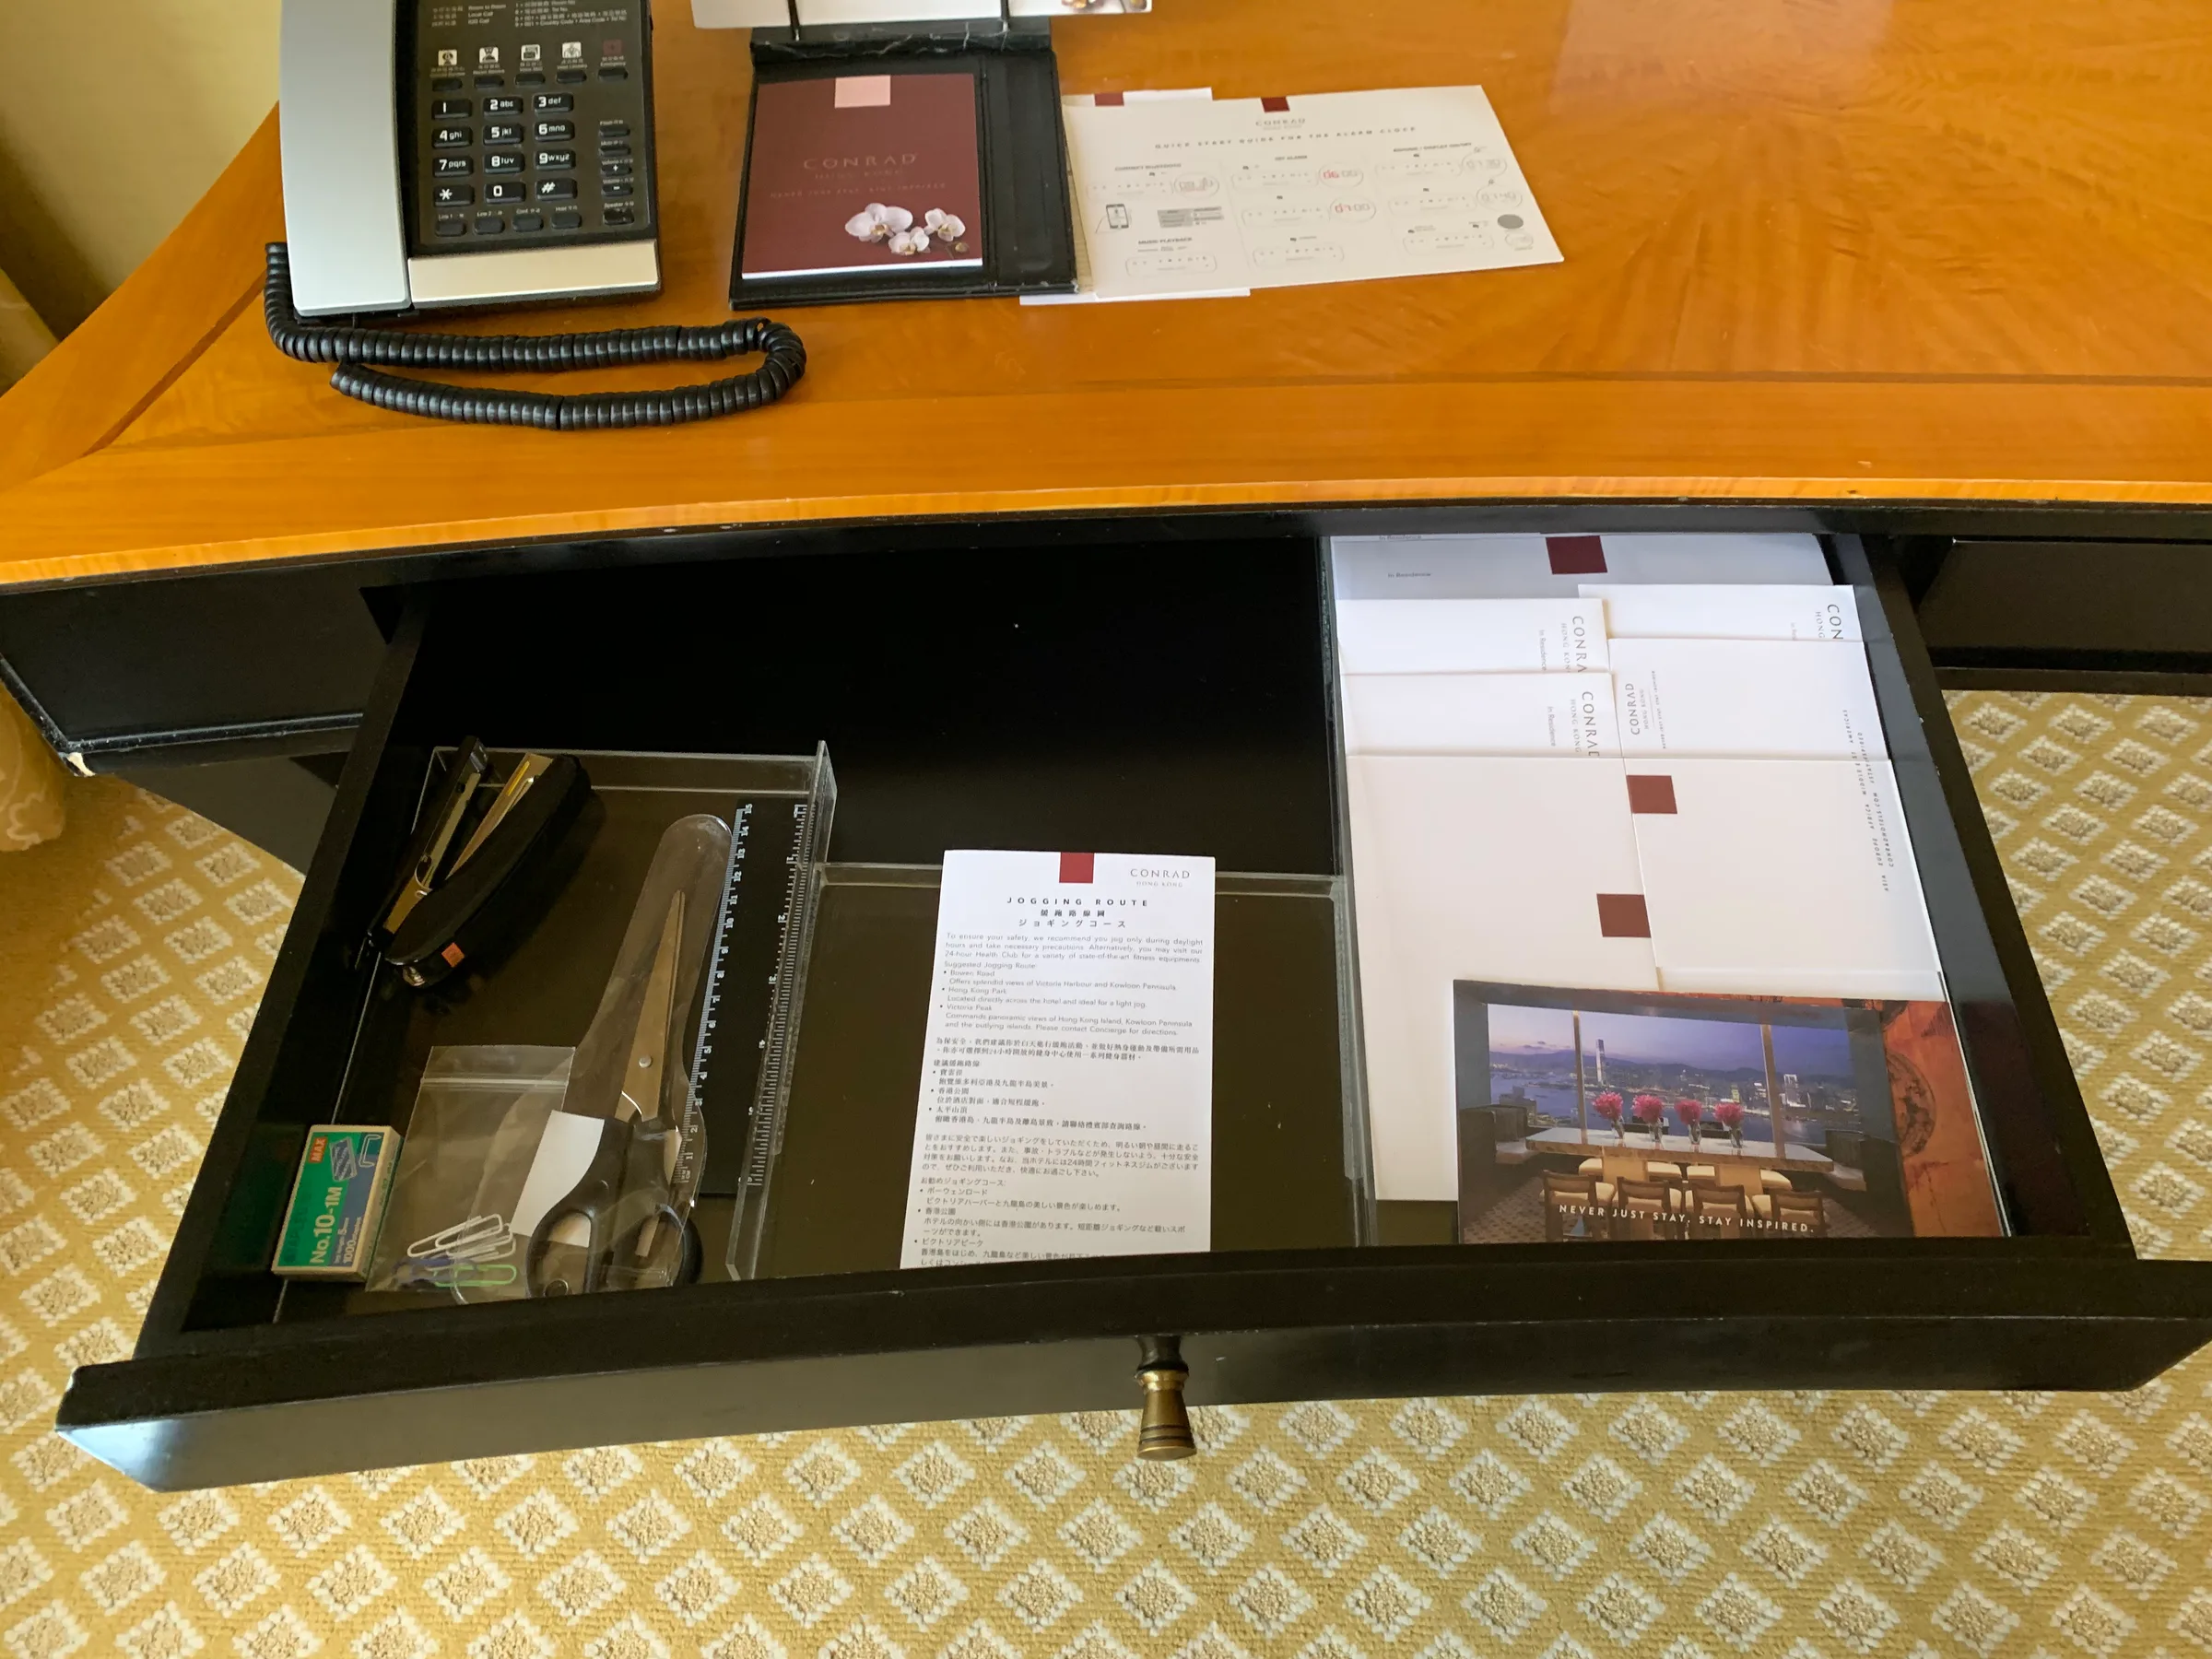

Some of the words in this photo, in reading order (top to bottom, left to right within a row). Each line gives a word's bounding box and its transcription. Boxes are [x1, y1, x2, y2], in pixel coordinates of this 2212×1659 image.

[490, 100, 498, 111] 2
[538, 96, 547, 107] 3
[1255, 118, 1305, 126] CONRAD
[439, 130, 448, 141] 4
[490, 126, 500, 138] 5
[538, 124, 547, 135] 6
[491, 155, 500, 168] 8
[538, 153, 547, 164] 9
[804, 153, 918, 170] CONRAD
[439, 159, 448, 171] 7
[1815, 612, 1825, 639] HONG
[1561, 623, 1570, 648] HONG
[1572, 616, 1587, 673] CONRA
[1563, 652, 1571, 673] KON
[1570, 699, 1578, 725] HONG
[1625, 683, 1641, 735] CONRAD
[1843, 710, 1854, 743] AMERICAS
[1572, 728, 1582, 753] KONG
[1851, 752, 1860, 767] EST
[1856, 769, 1867, 795] MIDDLE
[745, 804, 753, 815] 15
[1865, 804, 1875, 830] AFRICA
[741, 826, 749, 837] 14
[737, 848, 746, 859] 13
[1873, 837, 1883, 866] EUROPE
[734, 871, 742, 883] 12
[1130, 868, 1190, 879] CONRAD
[730, 894, 738, 905] 11
[1006, 897, 1082, 905] JOGGING
[1095, 899, 1148, 907] ROUTE
[725, 918, 734, 929] 10
[1018, 918, 1126, 928] ジョギングコース
[1146, 936, 1171, 945] during
[978, 996, 1004, 1005] directly
[1116, 1000, 1132, 1008] light
[975, 1022, 1005, 1030] outlying
[1058, 1016, 1078, 1024] Hong
[312, 1137, 326, 1162] MAX
[925, 1207, 957, 1216] 香港公園
[1559, 1205, 1605, 1217] NEVER
[1612, 1209, 1646, 1219] JUST
[1653, 1211, 1690, 1223] STAY.
[1699, 1215, 1733, 1226] STAY
[1740, 1218, 1814, 1233] INSPIRED.
[310, 1187, 343, 1264] No.10-1M
